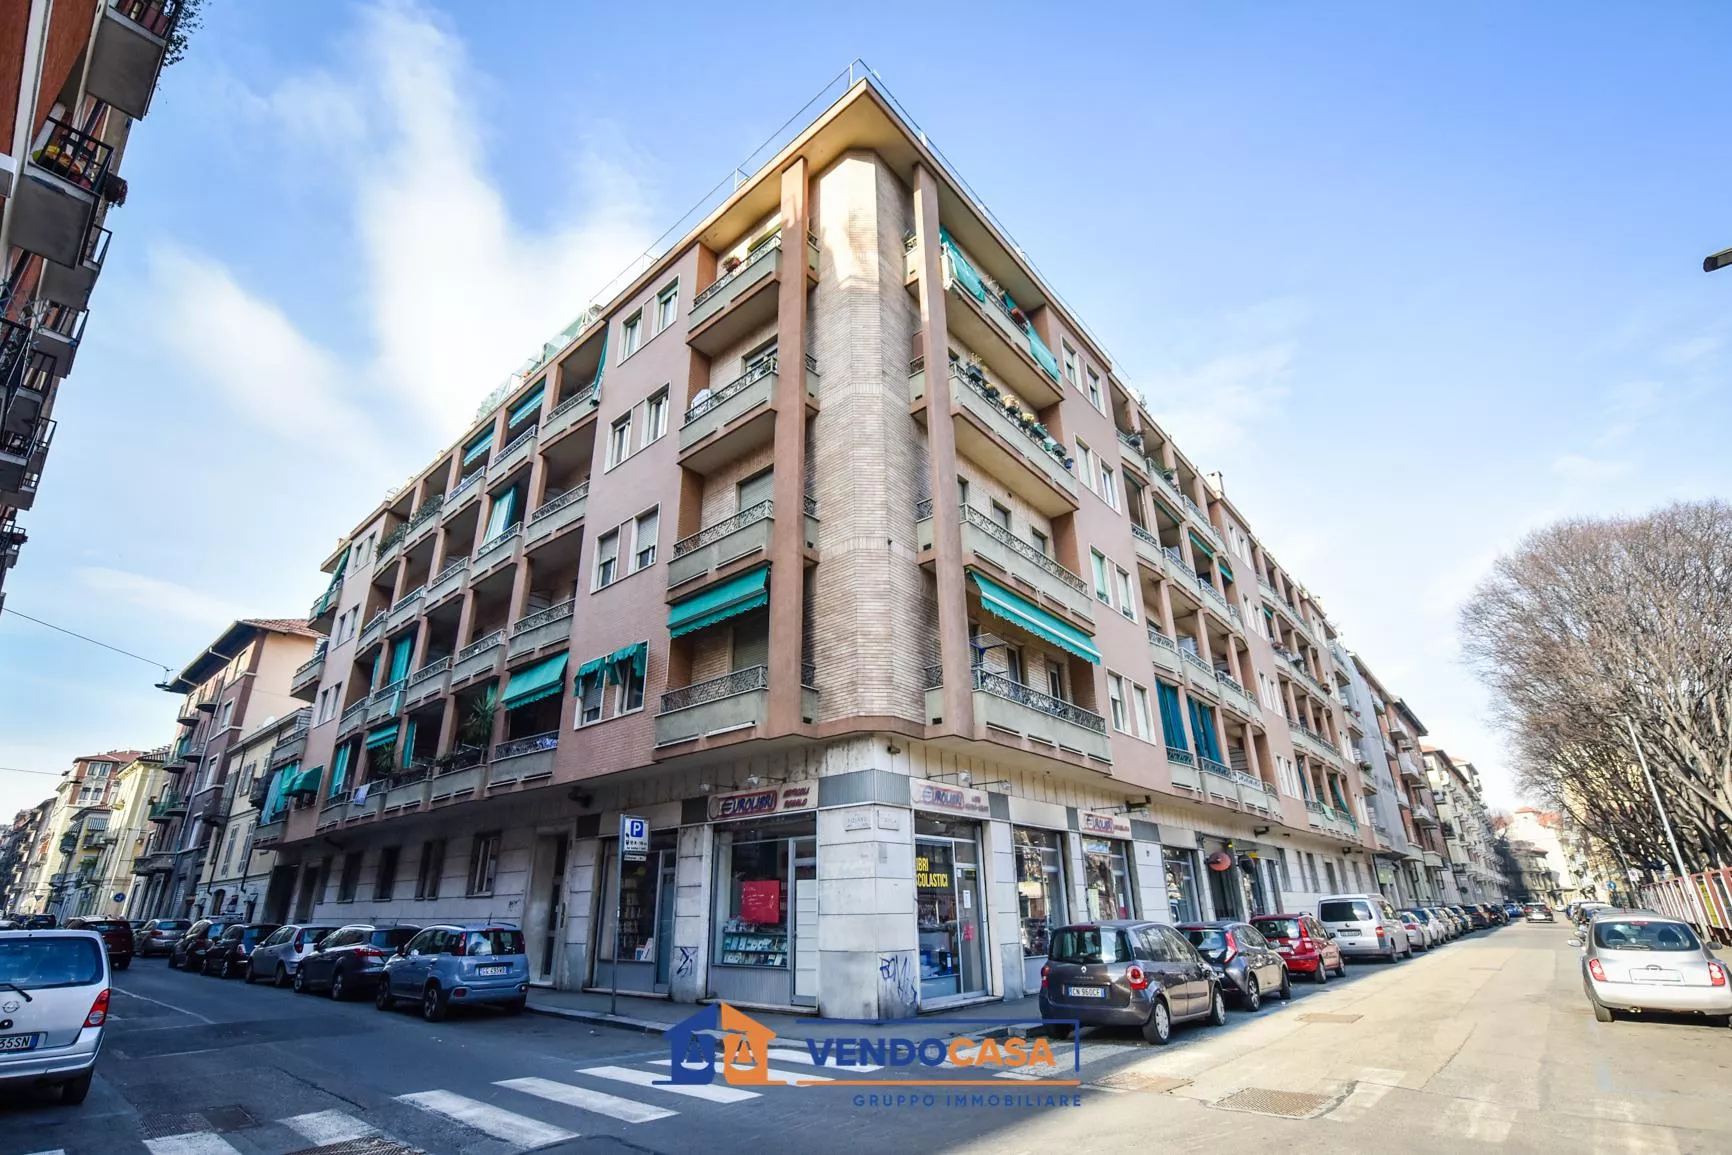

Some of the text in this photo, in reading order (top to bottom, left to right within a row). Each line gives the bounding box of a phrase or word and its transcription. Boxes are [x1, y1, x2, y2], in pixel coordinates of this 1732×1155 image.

[722, 794, 774, 814] EUROLIBRI
[633, 822, 642, 836] P
[915, 857, 929, 872] IBRI
